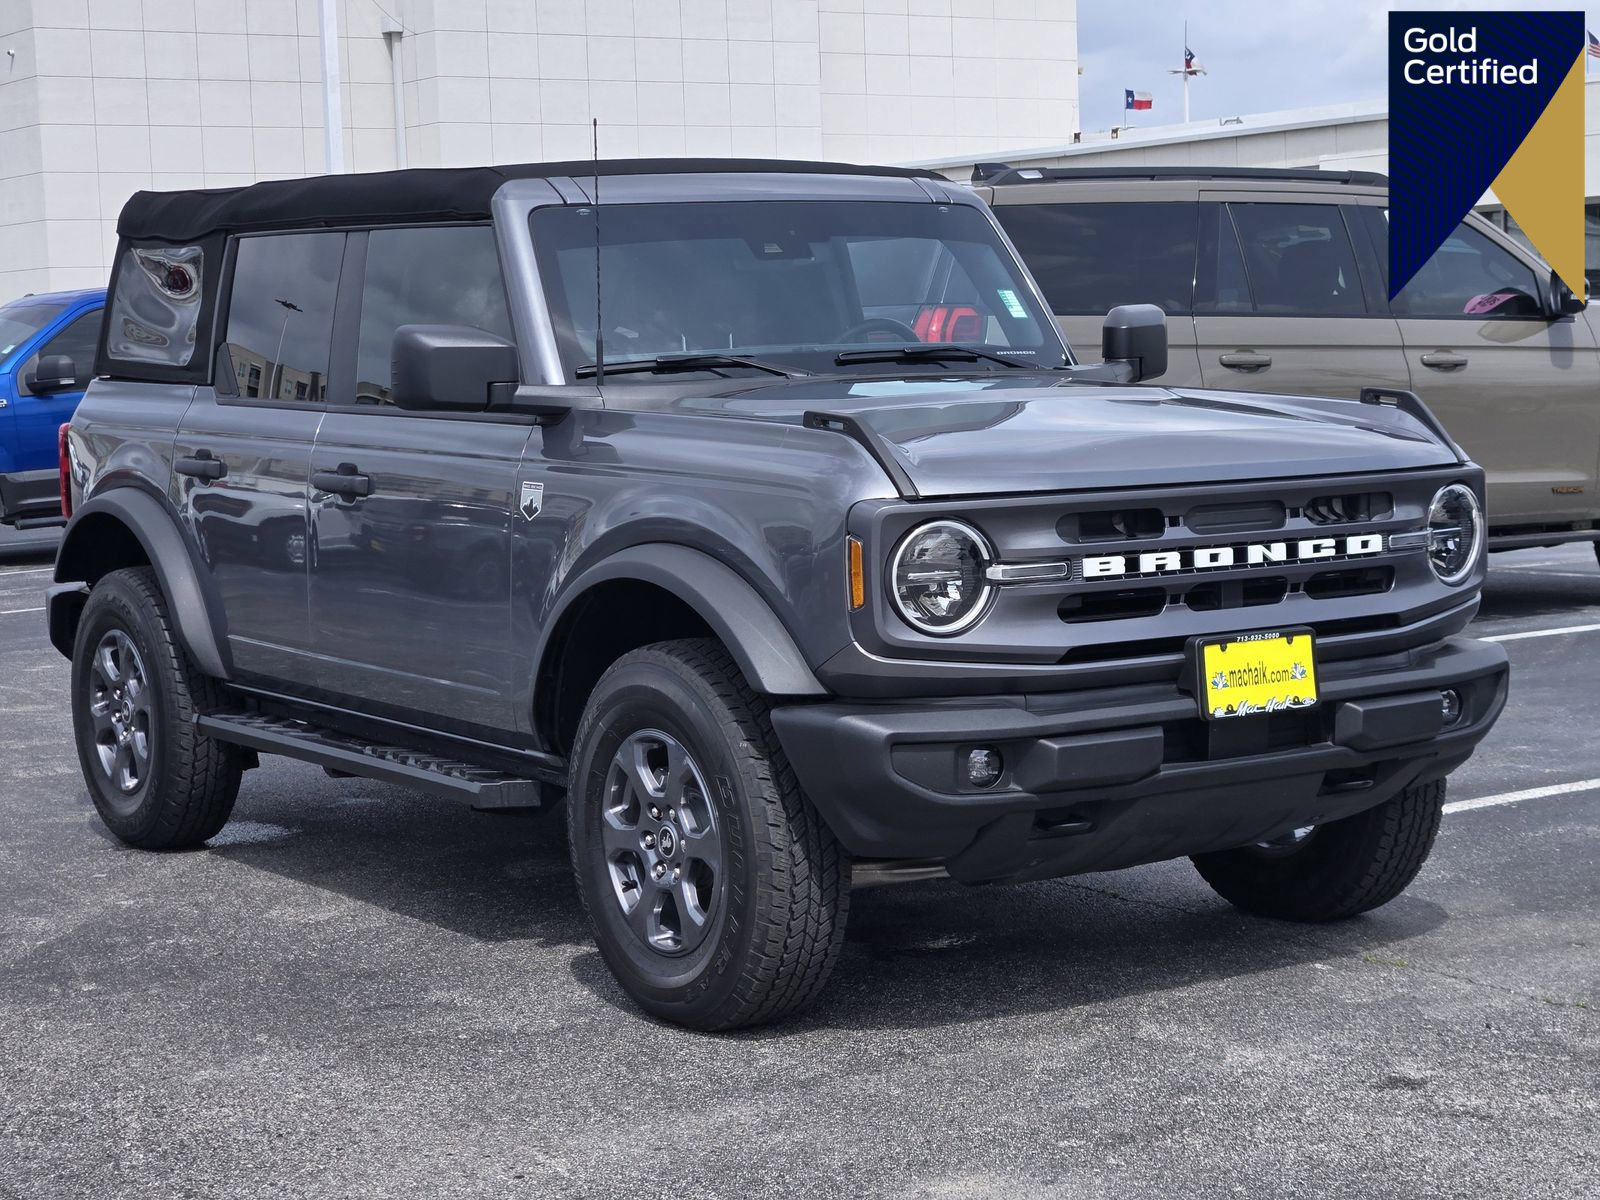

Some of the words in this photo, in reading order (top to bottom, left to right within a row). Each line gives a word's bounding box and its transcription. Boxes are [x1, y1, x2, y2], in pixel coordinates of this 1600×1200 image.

[1082, 533, 1383, 578] BRONCO
[1229, 661, 1290, 688] machaik.com
[1237, 700, 1261, 717] Mac
[1265, 695, 1294, 713] Haik
